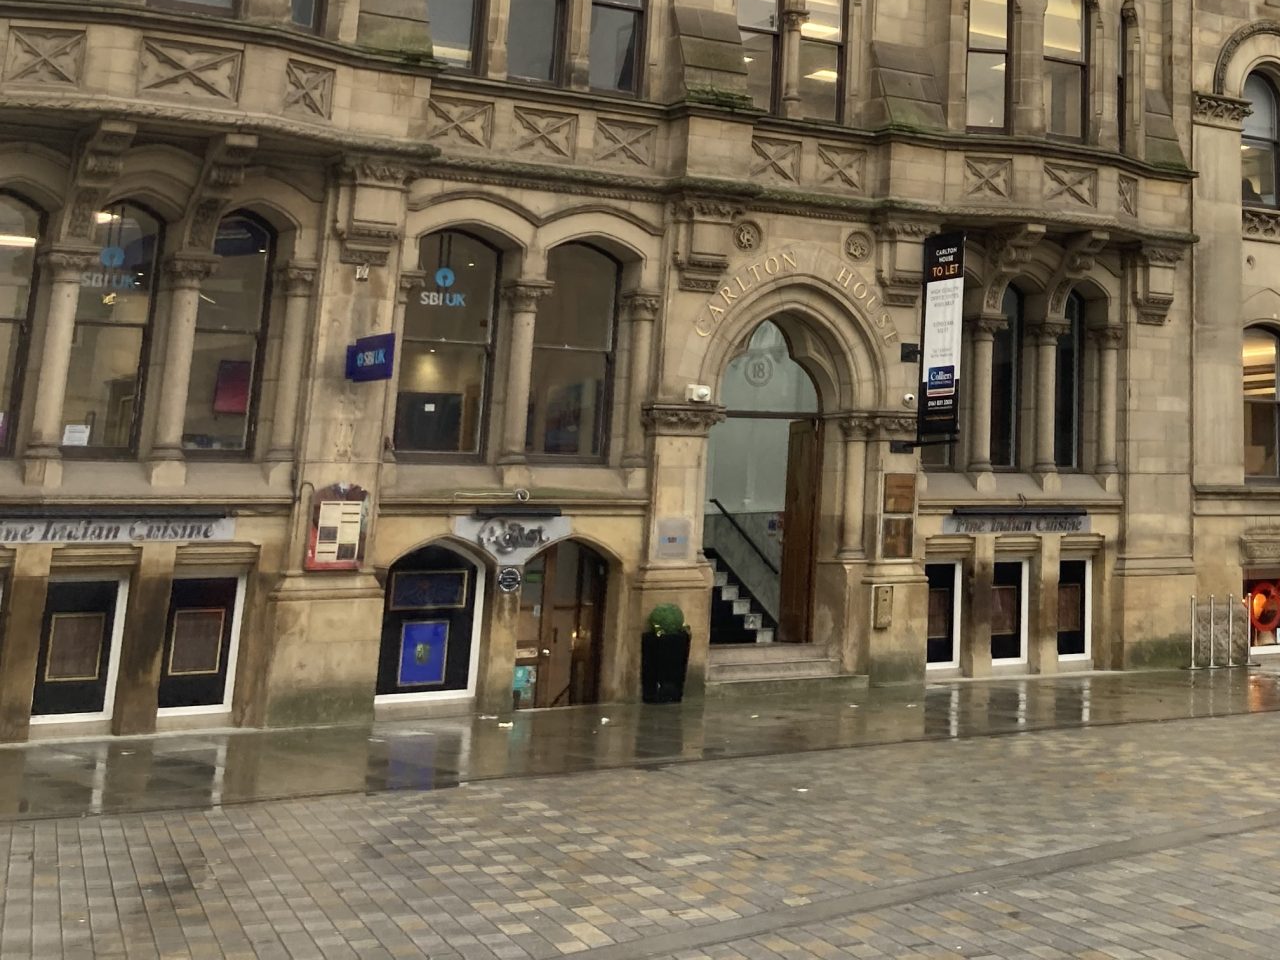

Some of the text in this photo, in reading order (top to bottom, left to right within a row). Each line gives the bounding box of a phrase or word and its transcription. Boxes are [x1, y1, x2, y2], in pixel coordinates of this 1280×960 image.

[936, 247, 957, 256] CARLTON
[932, 264, 959, 277] TO LET
[81, 272, 110, 288] SBI
[421, 291, 466, 307] SBI UK
[695, 250, 899, 347] CARLTON HOUSE
[752, 362, 765, 378] 18
[930, 371, 952, 381] Colliers
[0, 519, 216, 540] ine Indian Cuisine
[955, 516, 1082, 532] Fine Indian Cuisine
